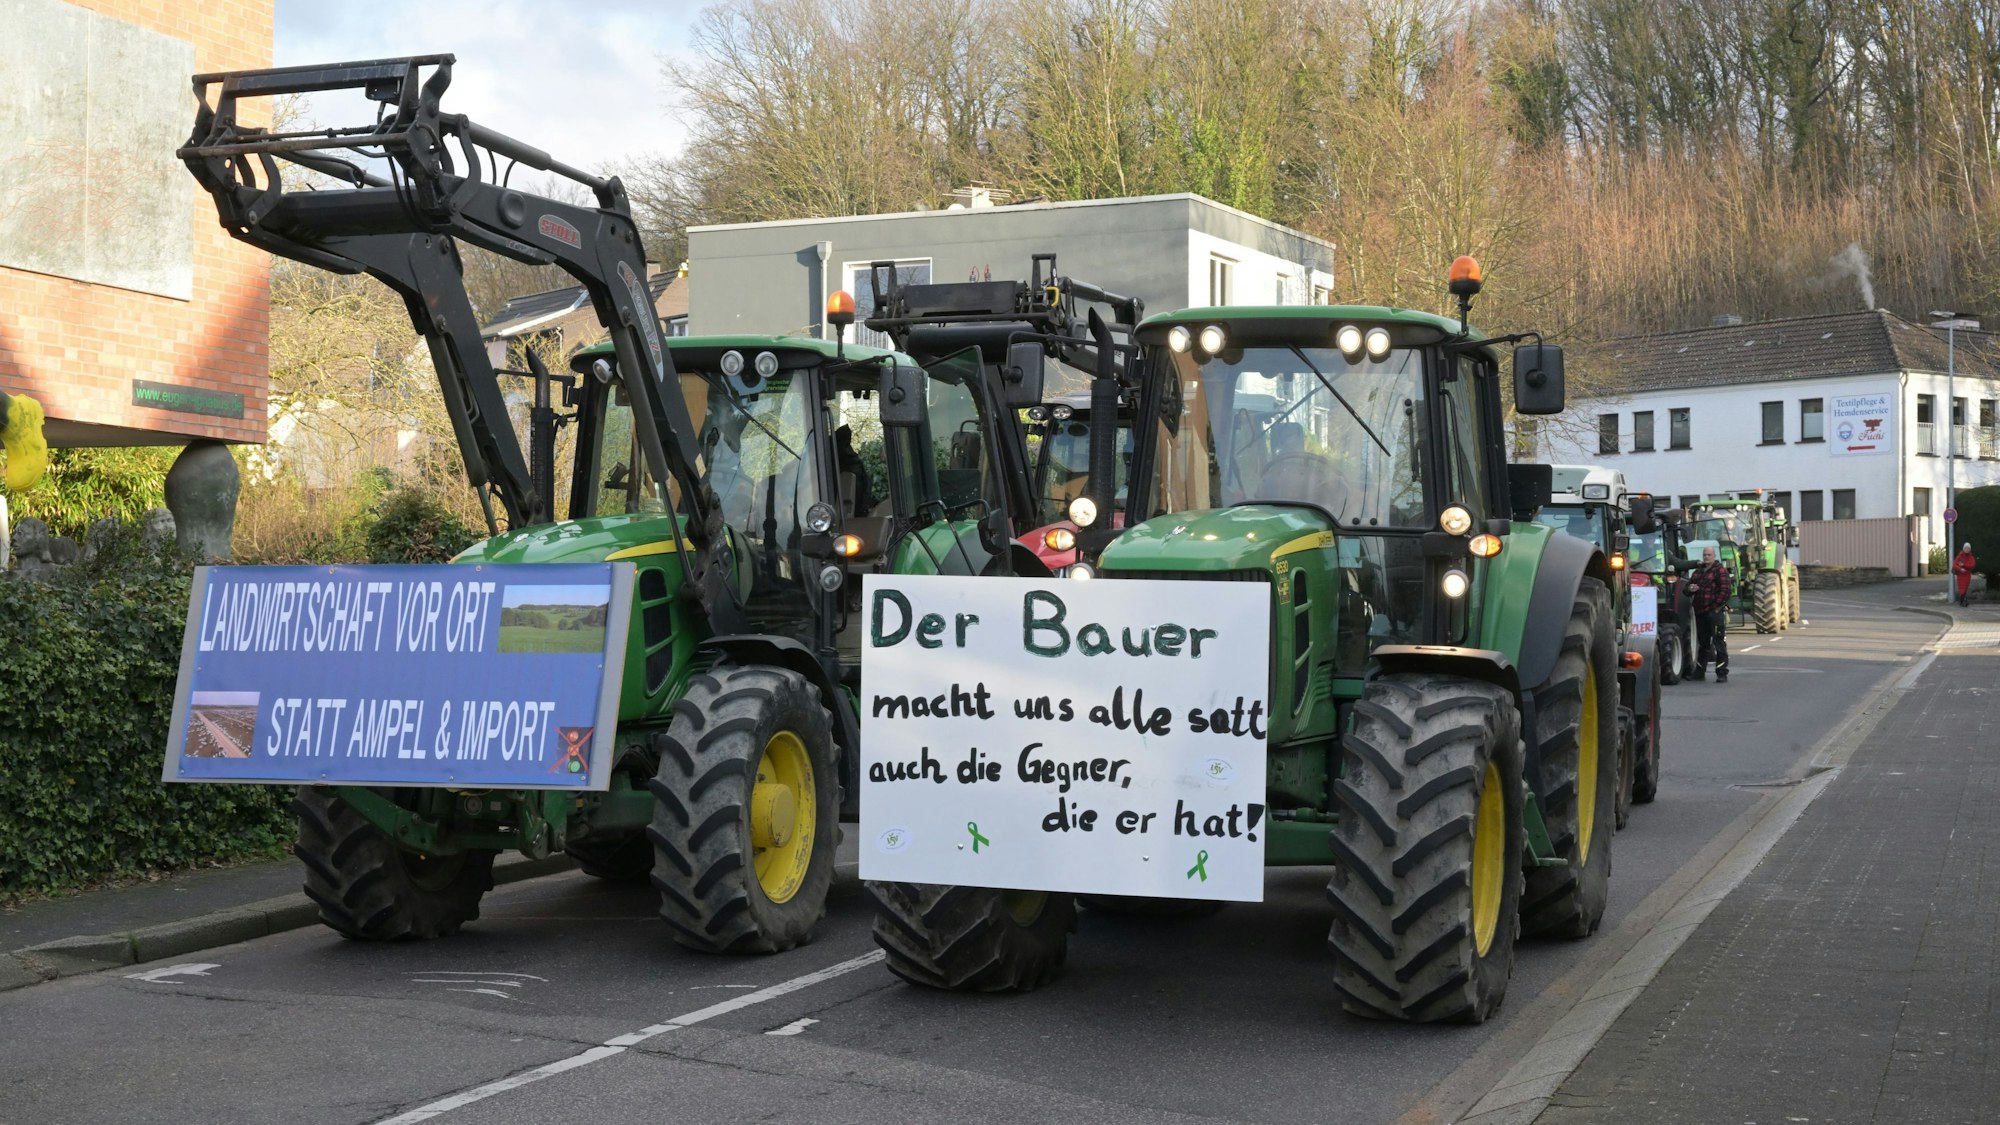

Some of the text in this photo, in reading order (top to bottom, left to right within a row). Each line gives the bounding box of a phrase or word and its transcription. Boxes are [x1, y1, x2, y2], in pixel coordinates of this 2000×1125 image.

[541, 219, 578, 244] STOLL
[1834, 407, 1889, 417] Hemdenservice
[1836, 396, 1886, 408] Textilpflege &
[200, 581, 496, 653] LANDWIRTSCHAFT VOR ORT
[870, 588, 1218, 659] Der Bauer
[267, 697, 556, 762] STATT AMPEL & IMPORT
[872, 683, 1266, 740] macht uns alle satt
[869, 743, 1132, 793] auch die Gegner,
[1041, 797, 1266, 843] die er hat!
